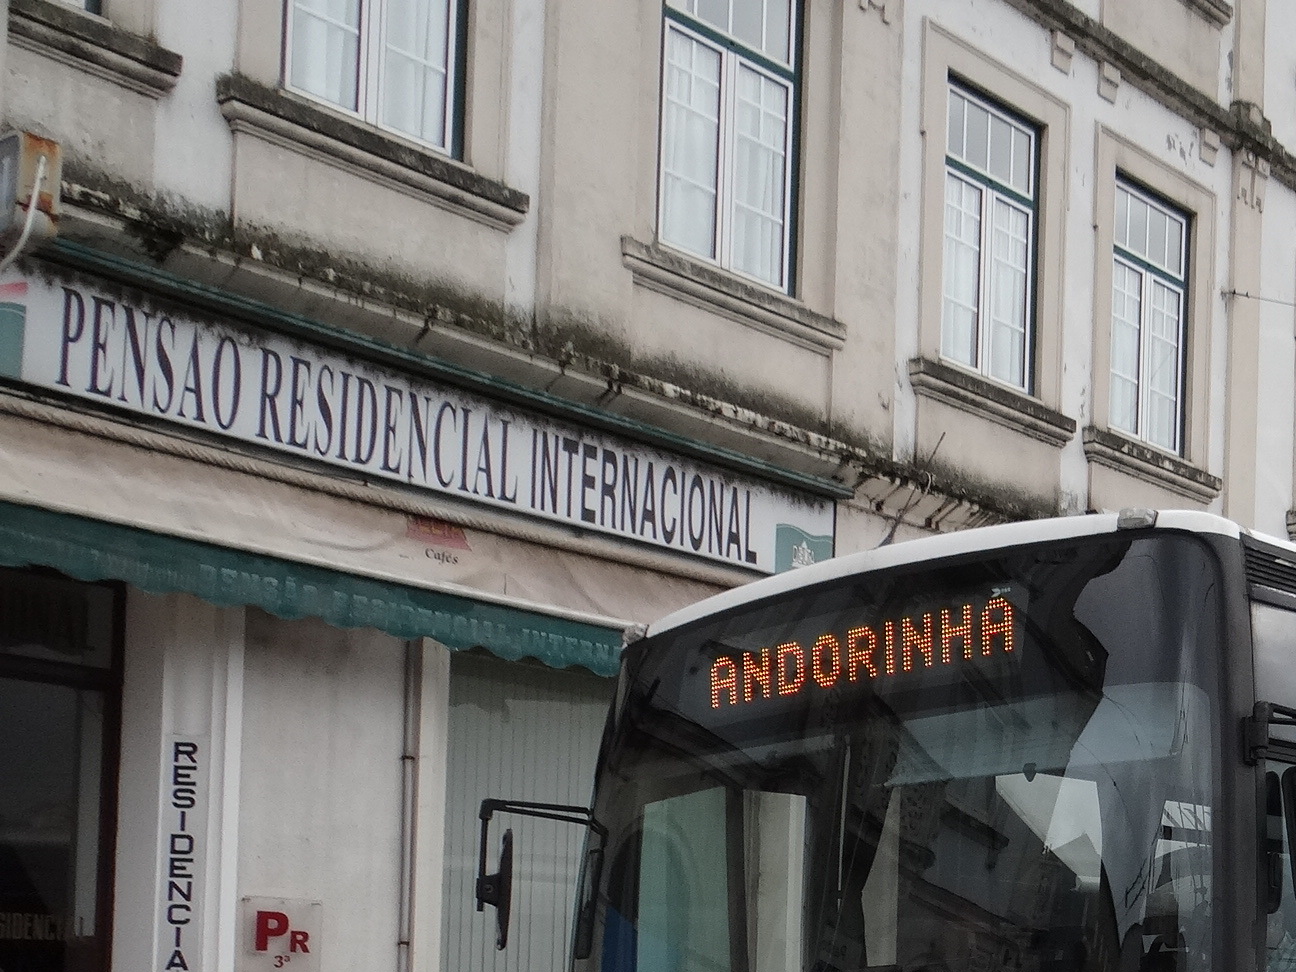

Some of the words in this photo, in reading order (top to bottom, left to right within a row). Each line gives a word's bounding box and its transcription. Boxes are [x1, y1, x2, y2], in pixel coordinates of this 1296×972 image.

[256, 346, 520, 505] RESIDENCIAL
[528, 426, 760, 566] INTERNACIONAL
[710, 597, 1014, 709] ANDORINHA
